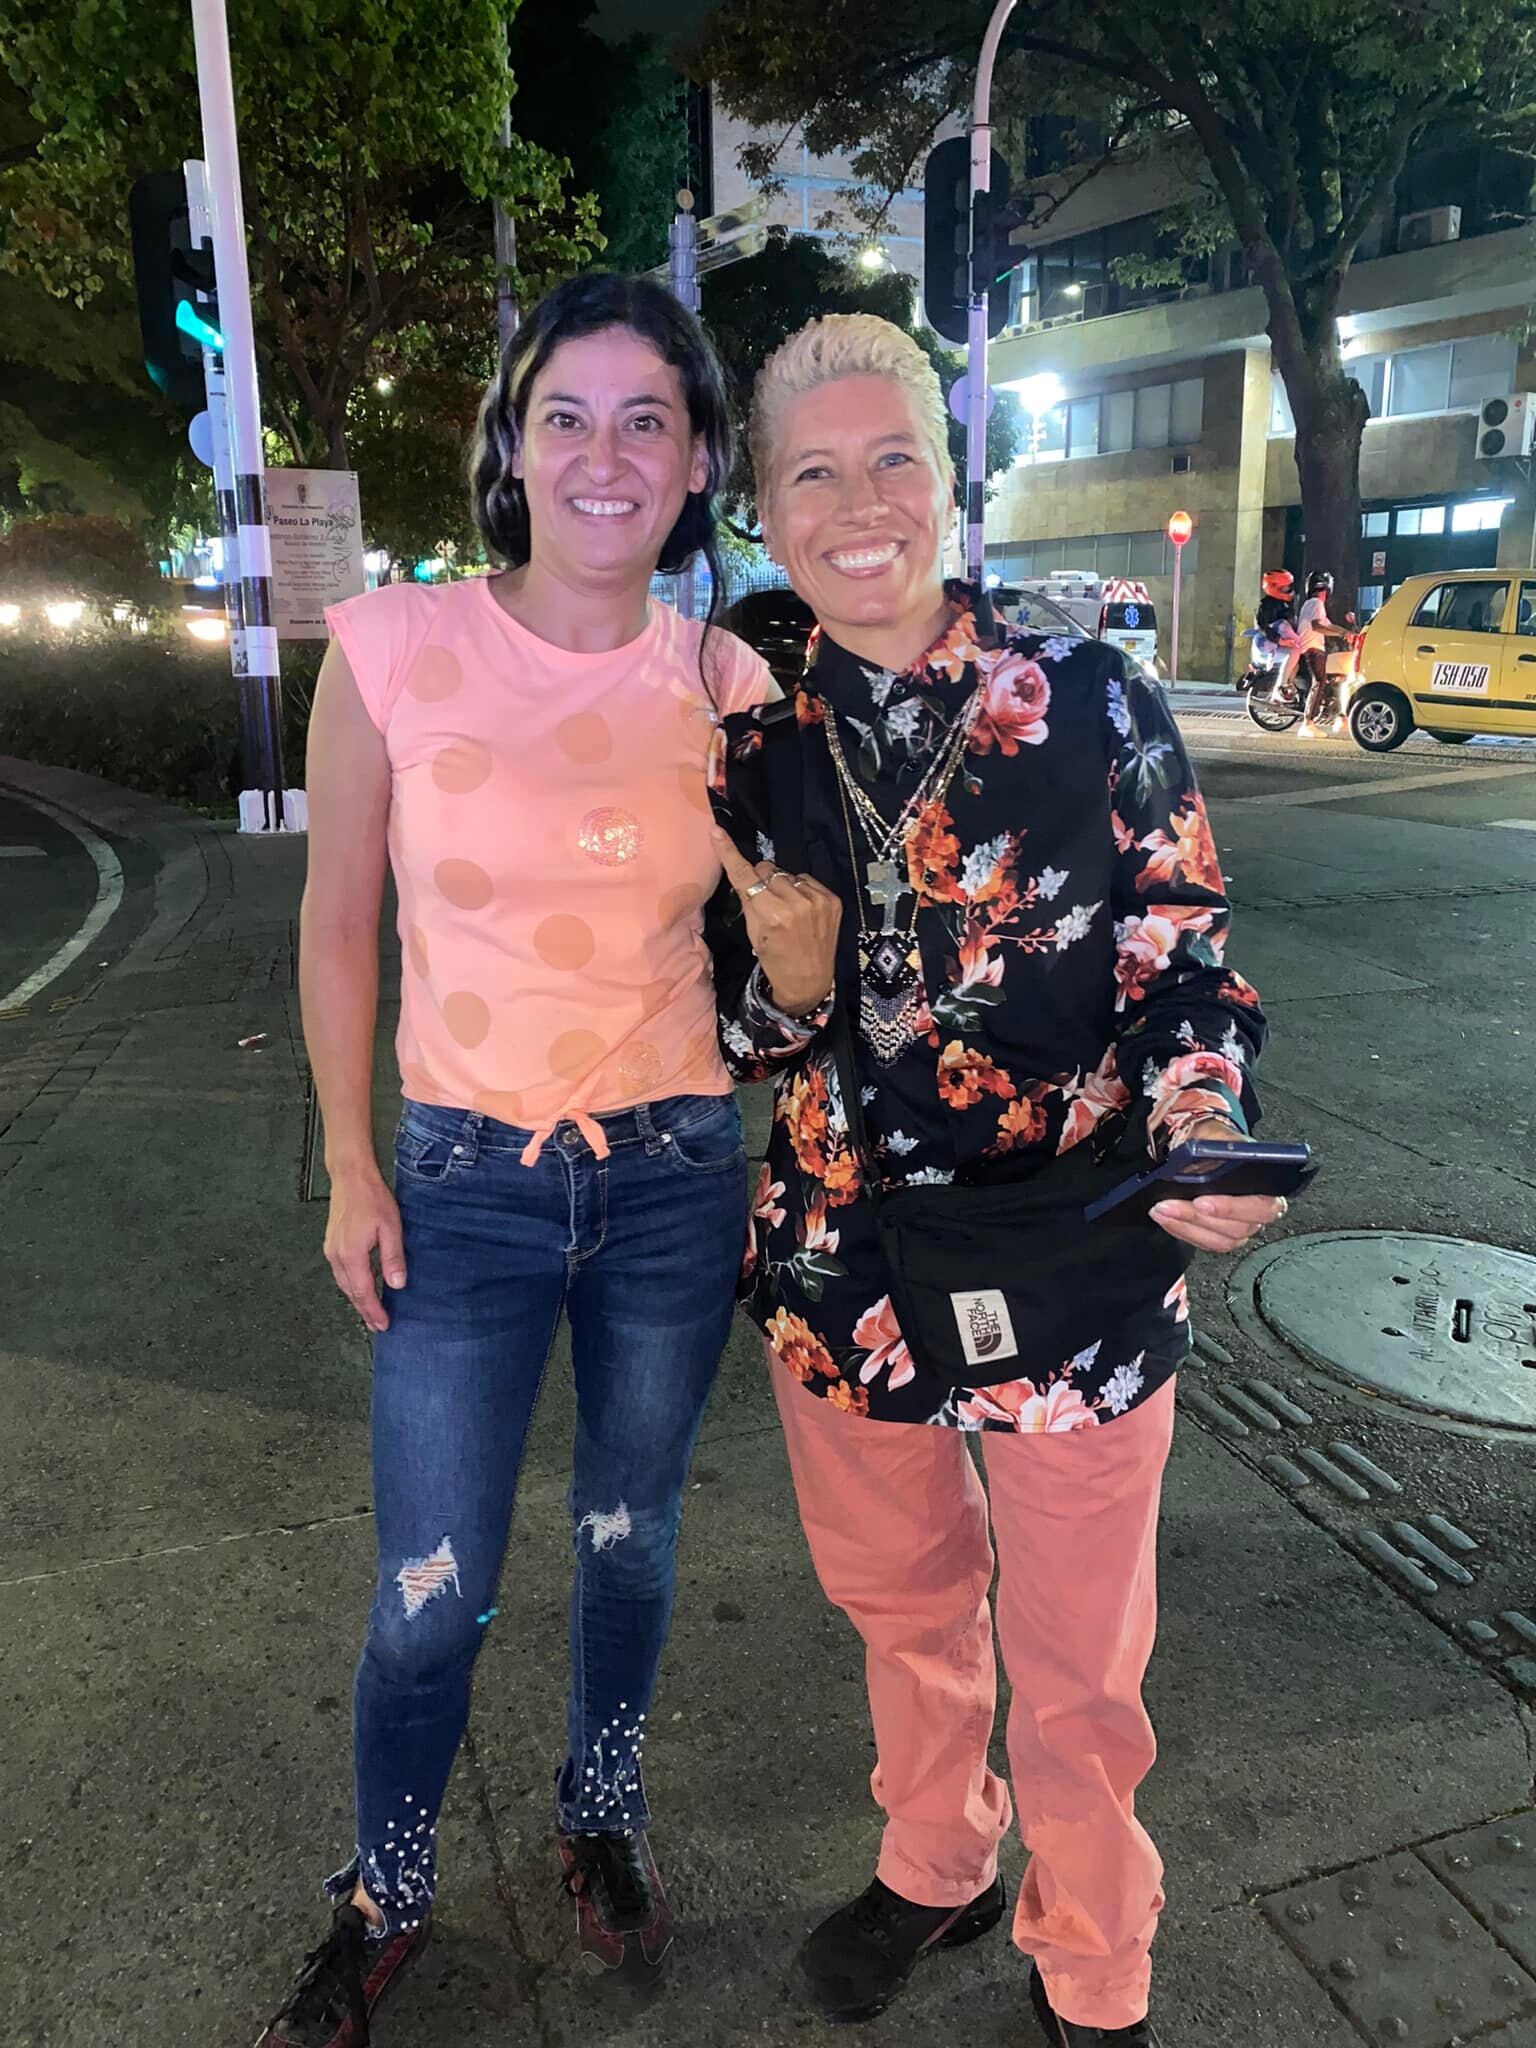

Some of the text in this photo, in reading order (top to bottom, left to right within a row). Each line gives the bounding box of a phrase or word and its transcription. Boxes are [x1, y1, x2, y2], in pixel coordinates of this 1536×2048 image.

[273, 515, 333, 528] Paseo La Playa
[966, 1307, 982, 1337] FACE
[973, 1297, 991, 1335] NORTH
[987, 1309, 1001, 1333] THE
